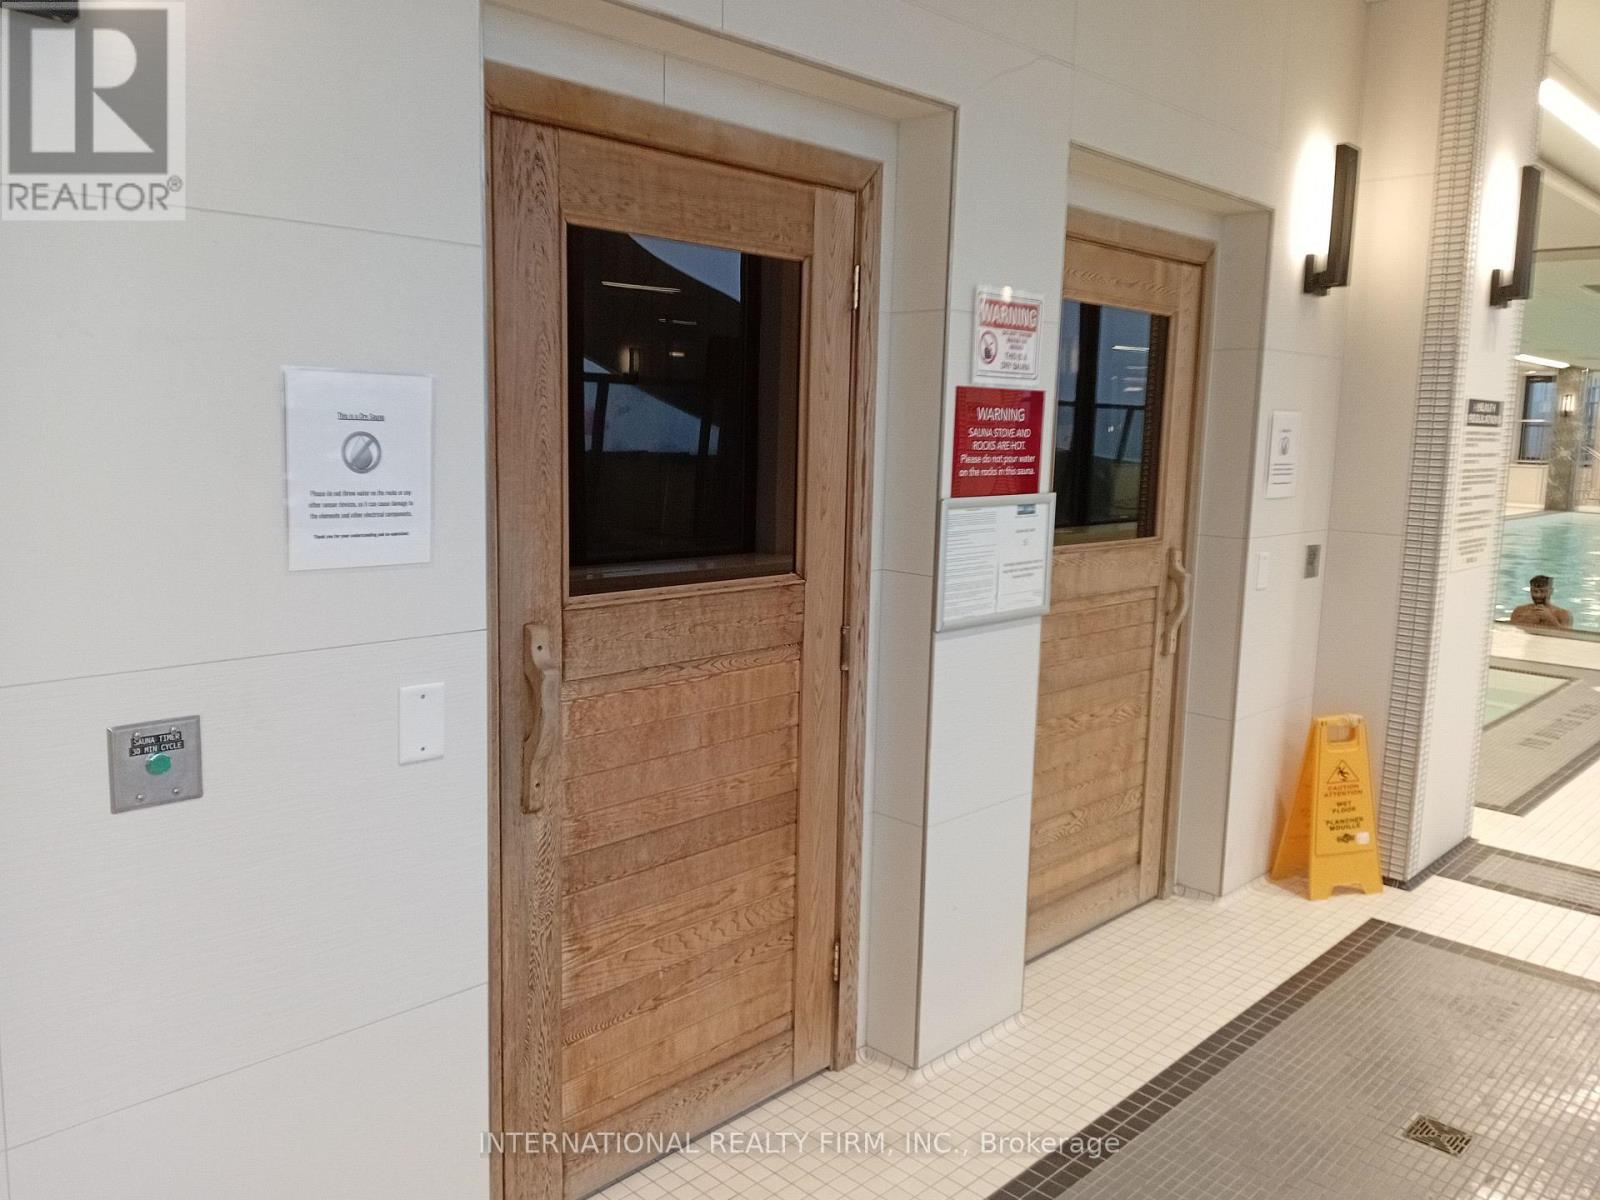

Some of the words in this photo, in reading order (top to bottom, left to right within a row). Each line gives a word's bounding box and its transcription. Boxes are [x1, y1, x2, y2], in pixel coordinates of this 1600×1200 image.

[981, 301, 1038, 328] WARNING
[976, 406, 1026, 422] WARNING
[968, 427, 993, 438] SAUNA
[993, 428, 1016, 438] STOVE
[1016, 428, 1032, 438] AND
[972, 441, 996, 450] ROCKS
[997, 441, 1010, 450] ARE
[960, 454, 981, 464] Please
[982, 454, 991, 463] do
[992, 455, 1003, 463] not
[1003, 455, 1018, 465] pour
[1018, 455, 1036, 463] water
[959, 469, 969, 477] on
[969, 467, 980, 477] the
[980, 467, 998, 476] rocks
[998, 467, 1005, 475] in
[1005, 466, 1017, 475] this
[133, 736, 155, 746] SAUNA
[159, 731, 181, 742] TIMER
[144, 746, 158, 754] MIN
[160, 742, 183, 751] CYCLE
